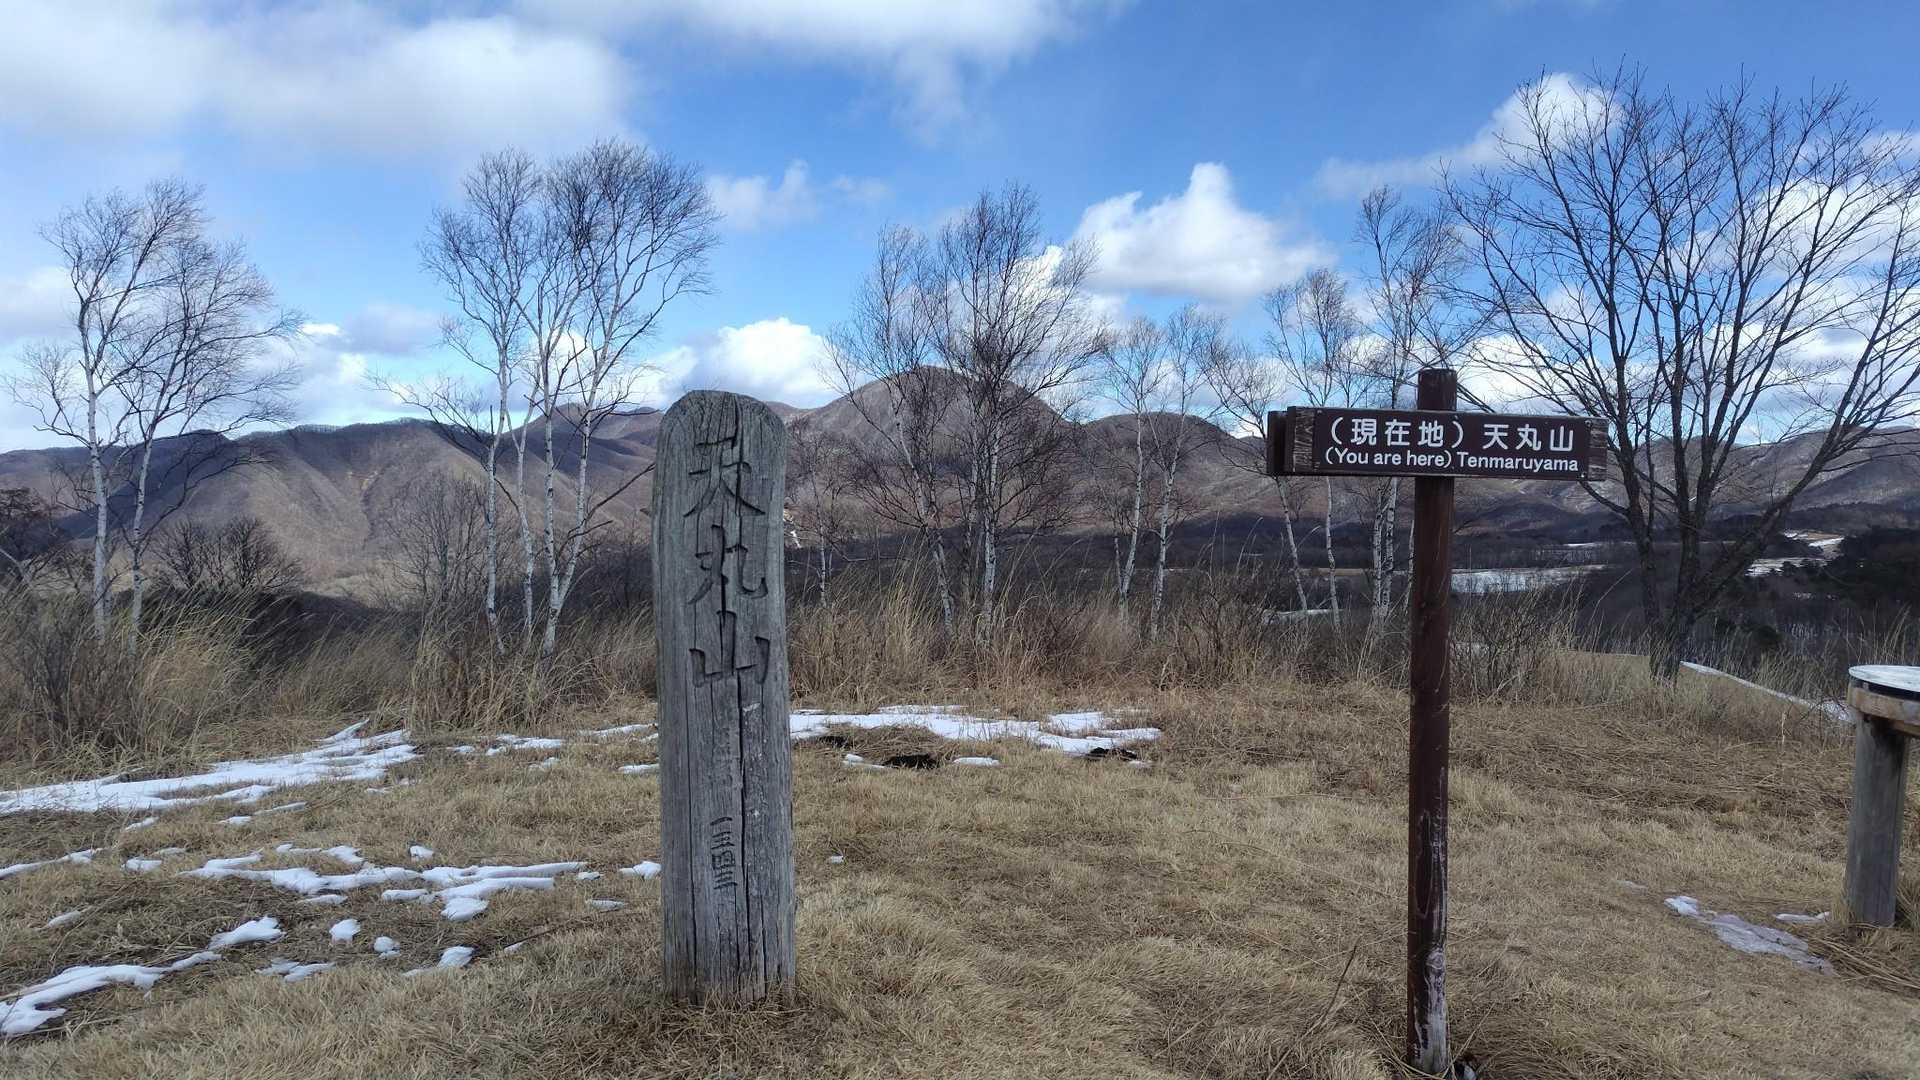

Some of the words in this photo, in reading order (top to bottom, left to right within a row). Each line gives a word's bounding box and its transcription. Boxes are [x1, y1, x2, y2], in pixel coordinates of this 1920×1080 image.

[1483, 423, 1574, 452] 天丸山
[1325, 447, 1369, 465] (You
[1373, 452, 1401, 465] are
[1406, 450, 1451, 468] here)
[1457, 452, 1578, 473] Tenmaruyama
[683, 435, 770, 690] 天丸山
